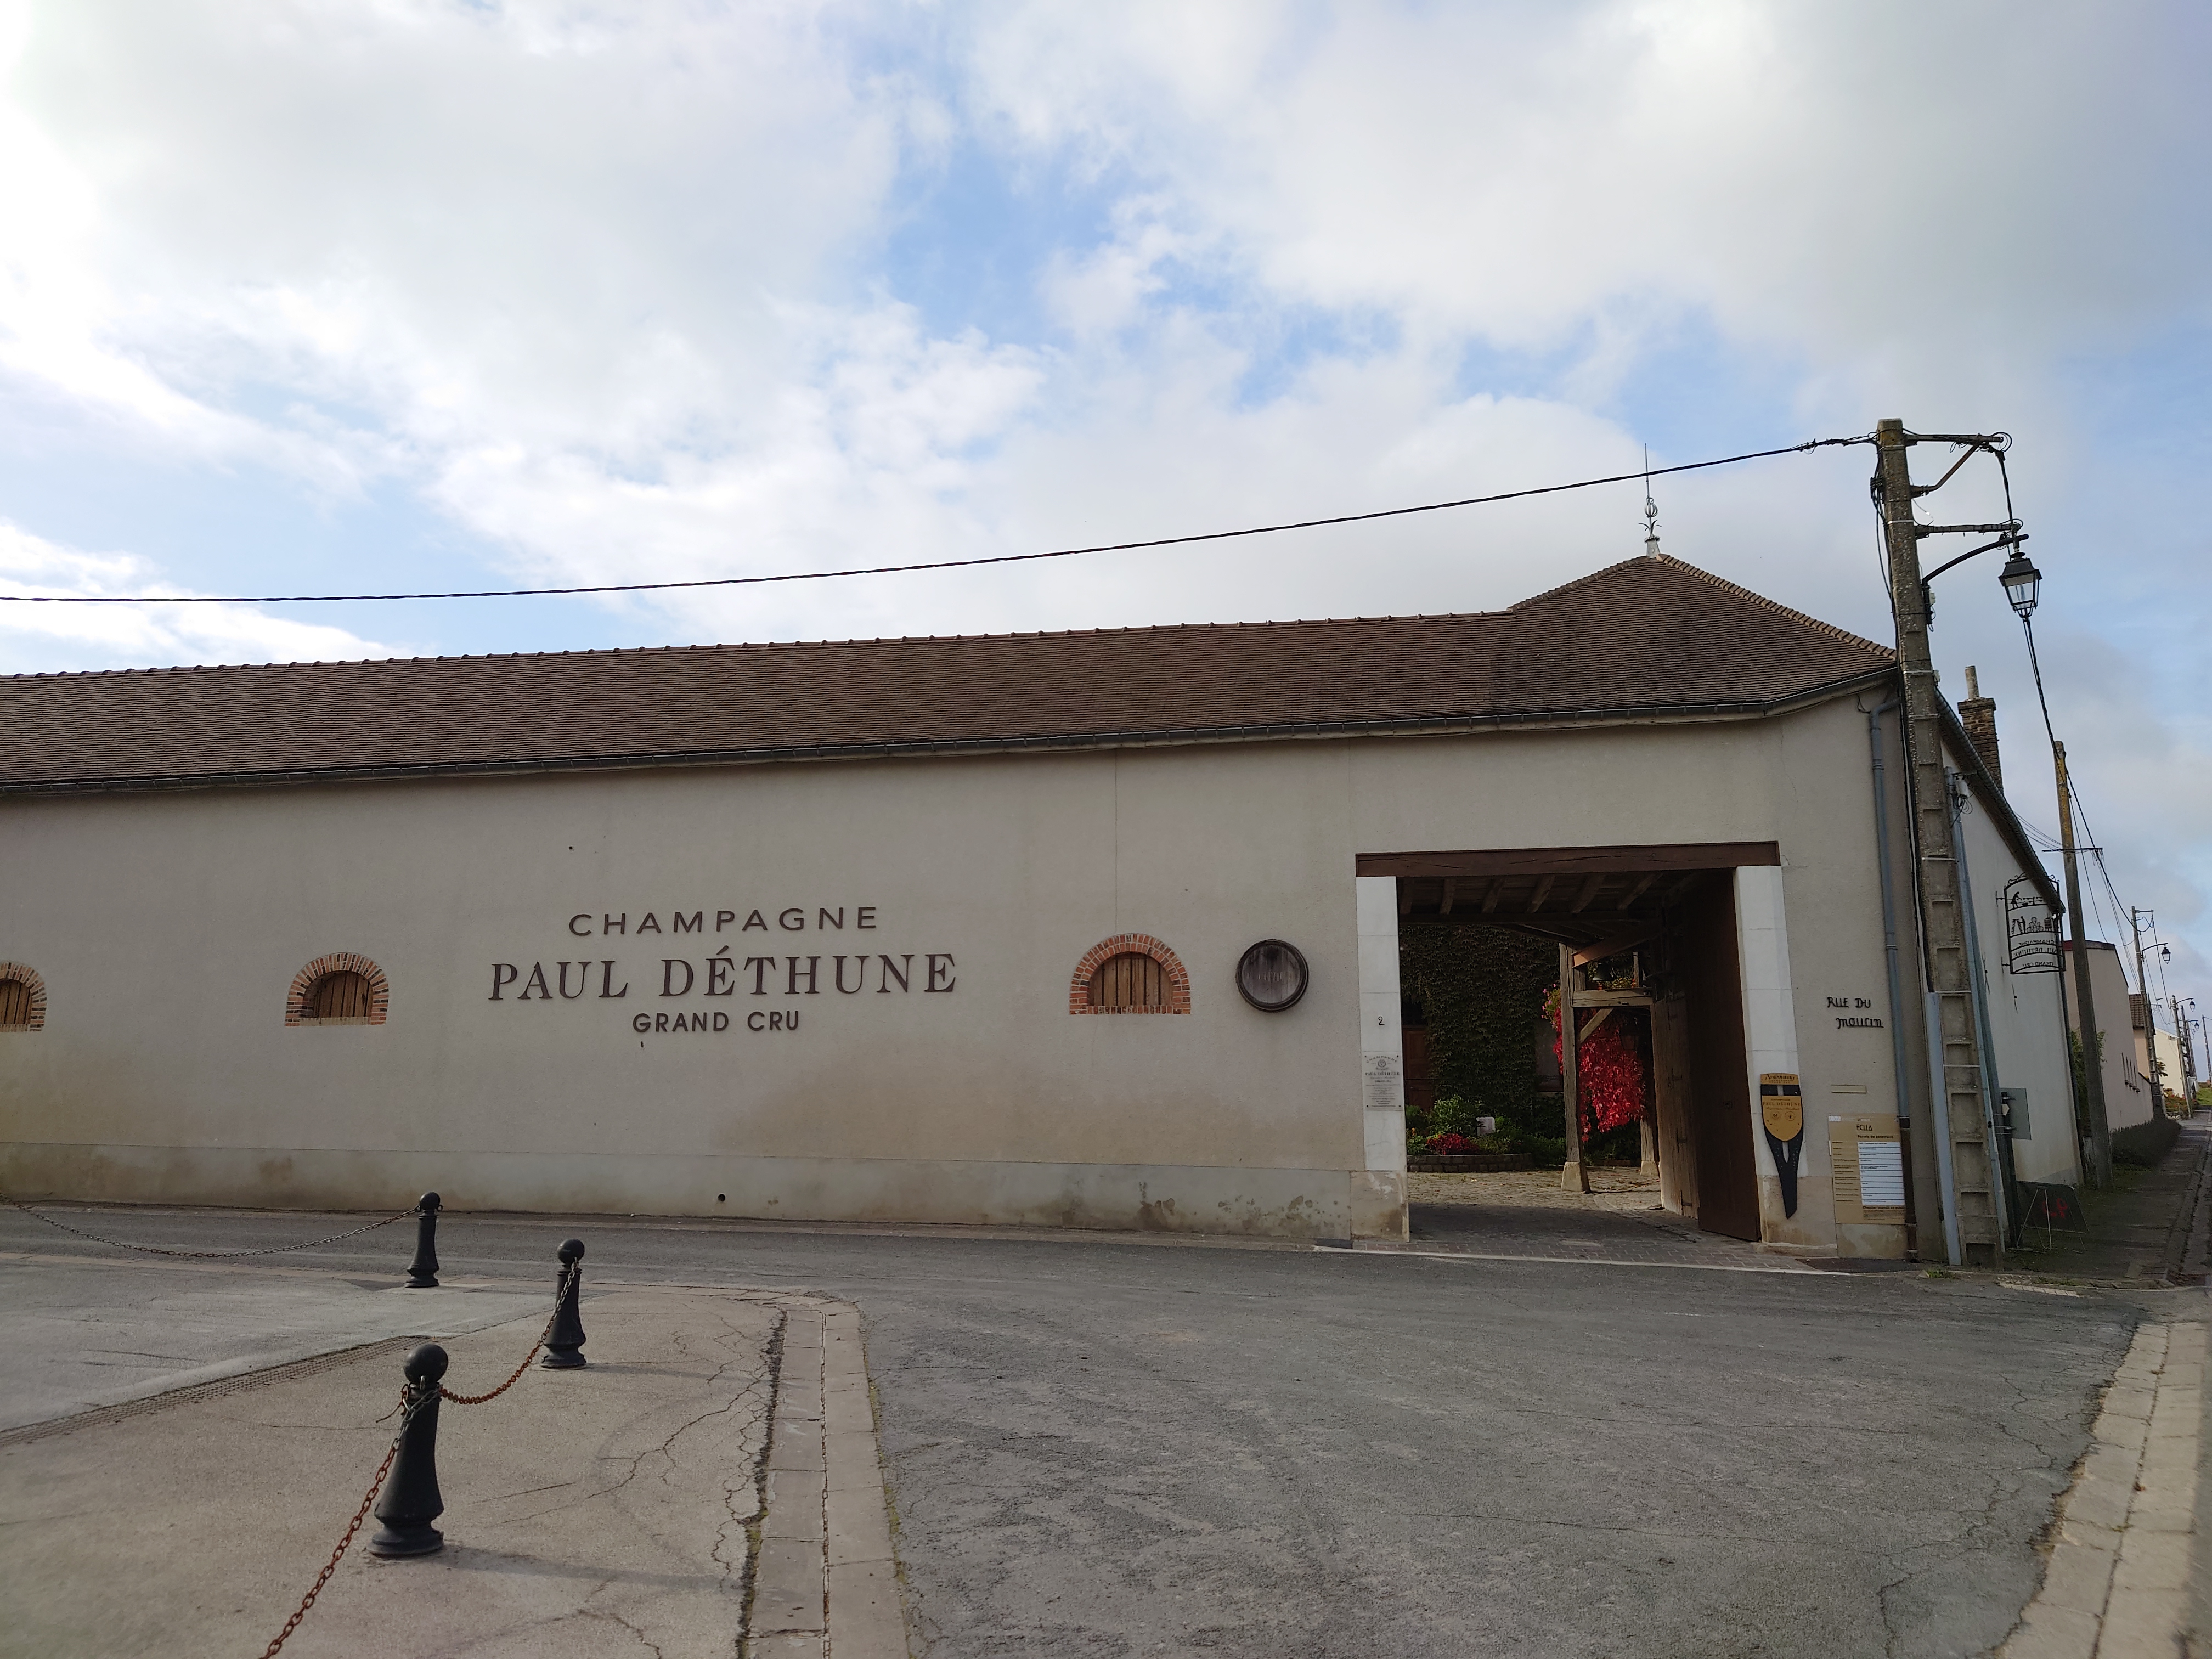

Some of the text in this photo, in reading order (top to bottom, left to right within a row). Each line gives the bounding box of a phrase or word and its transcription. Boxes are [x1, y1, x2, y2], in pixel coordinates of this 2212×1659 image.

[569, 907, 877, 936] CHAMPAGNE
[488, 945, 956, 1000] PAUL DÉTHUNE
[1827, 997, 1871, 1008] RUE DU
[633, 1011, 799, 1033] GRAND CRU
[1378, 1016, 1386, 1026] 2
